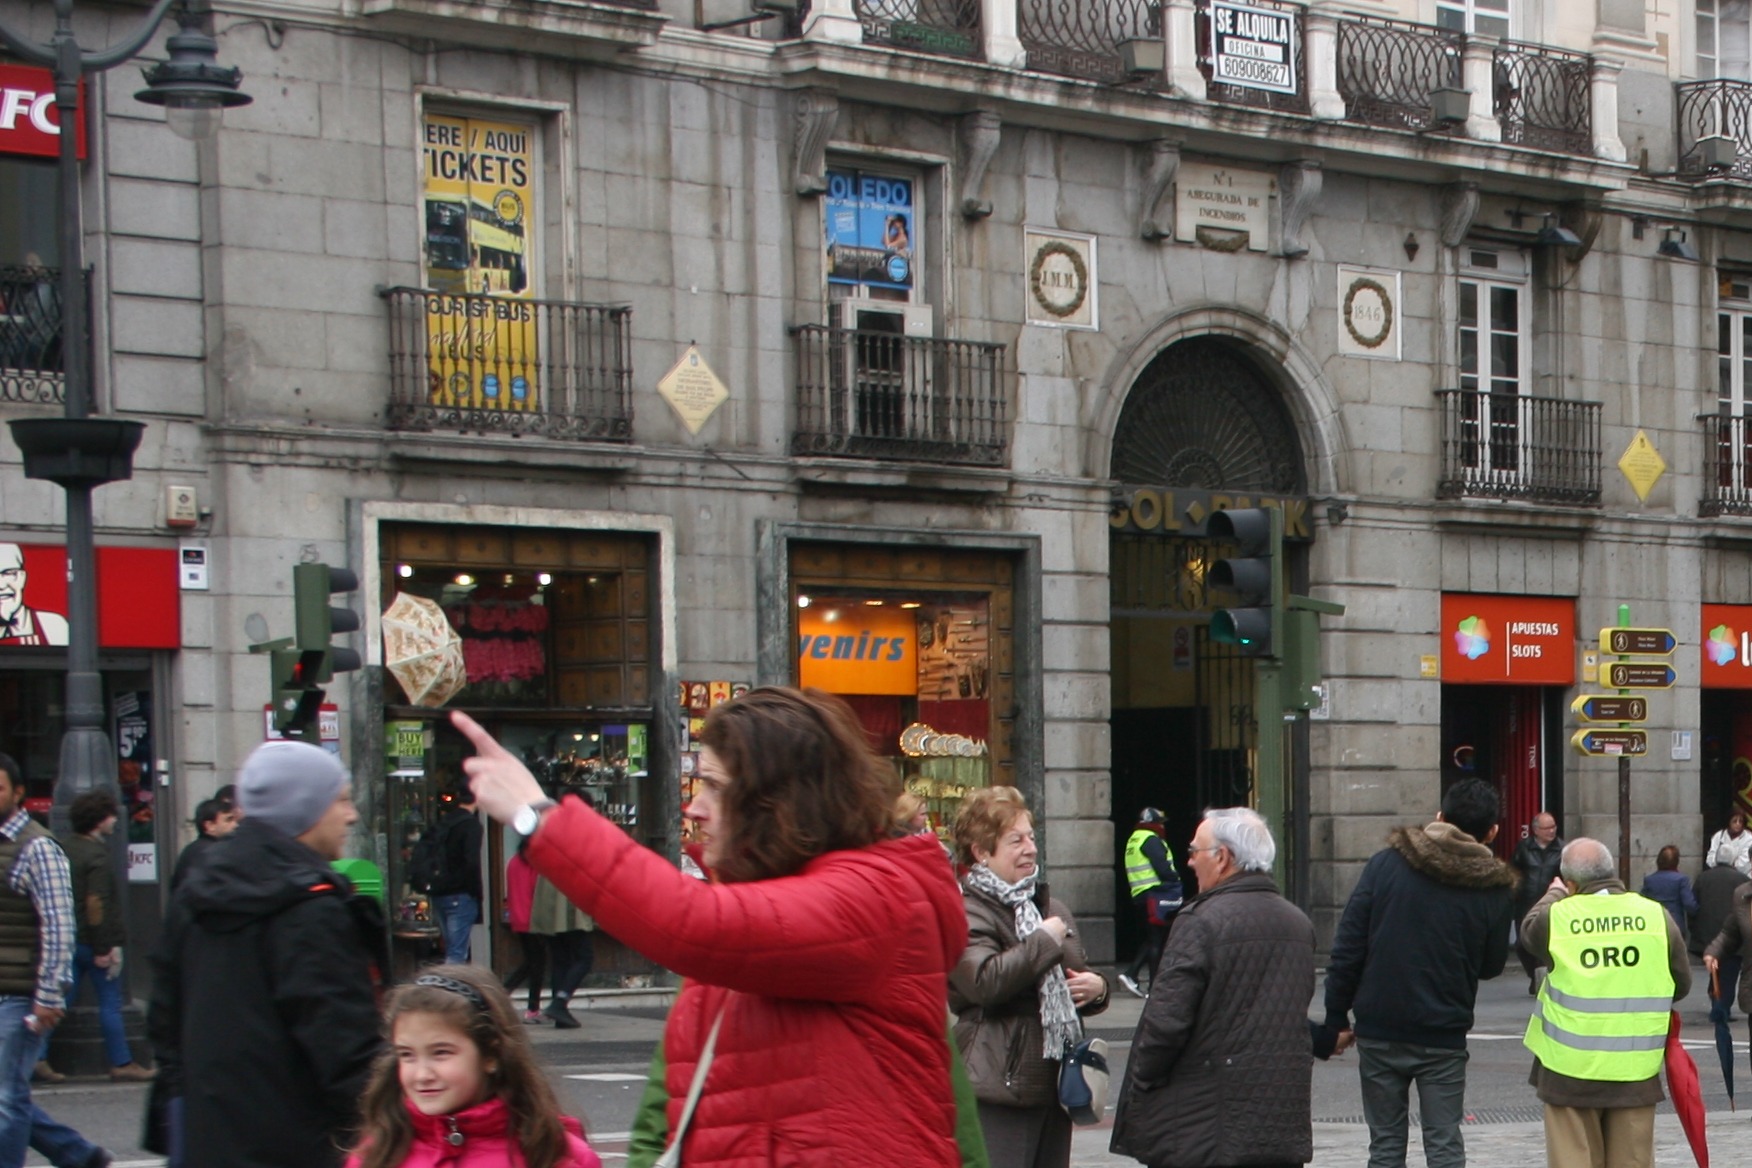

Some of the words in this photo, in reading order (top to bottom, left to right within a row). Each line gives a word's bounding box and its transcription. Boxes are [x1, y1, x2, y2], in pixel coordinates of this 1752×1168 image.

[1217, 8, 1233, 34] SE
[1237, 11, 1288, 44] ALQUILA
[1228, 40, 1265, 57] OFICINA
[1224, 57, 1286, 84] 609008627
[0, 87, 61, 135] FC
[424, 124, 461, 146] ERE
[485, 130, 526, 154] AQUÍ
[826, 175, 907, 206] OLEDO
[1187, 189, 1242, 206] ASEGURADA
[1247, 196, 1259, 208] DE
[1199, 207, 1247, 223] INCENDIOS
[428, 299, 491, 318] OURST
[1354, 304, 1380, 322] 1846
[1210, 494, 1310, 538] PK
[1512, 623, 1559, 635] APUESTAS
[1512, 645, 1541, 658] SLOTS
[399, 732, 421, 744] BUY
[1521, 824, 1529, 839] FO
[134, 853, 152, 865] KFC
[1570, 916, 1646, 935] COMPRO
[1580, 945, 1640, 969] ORO
